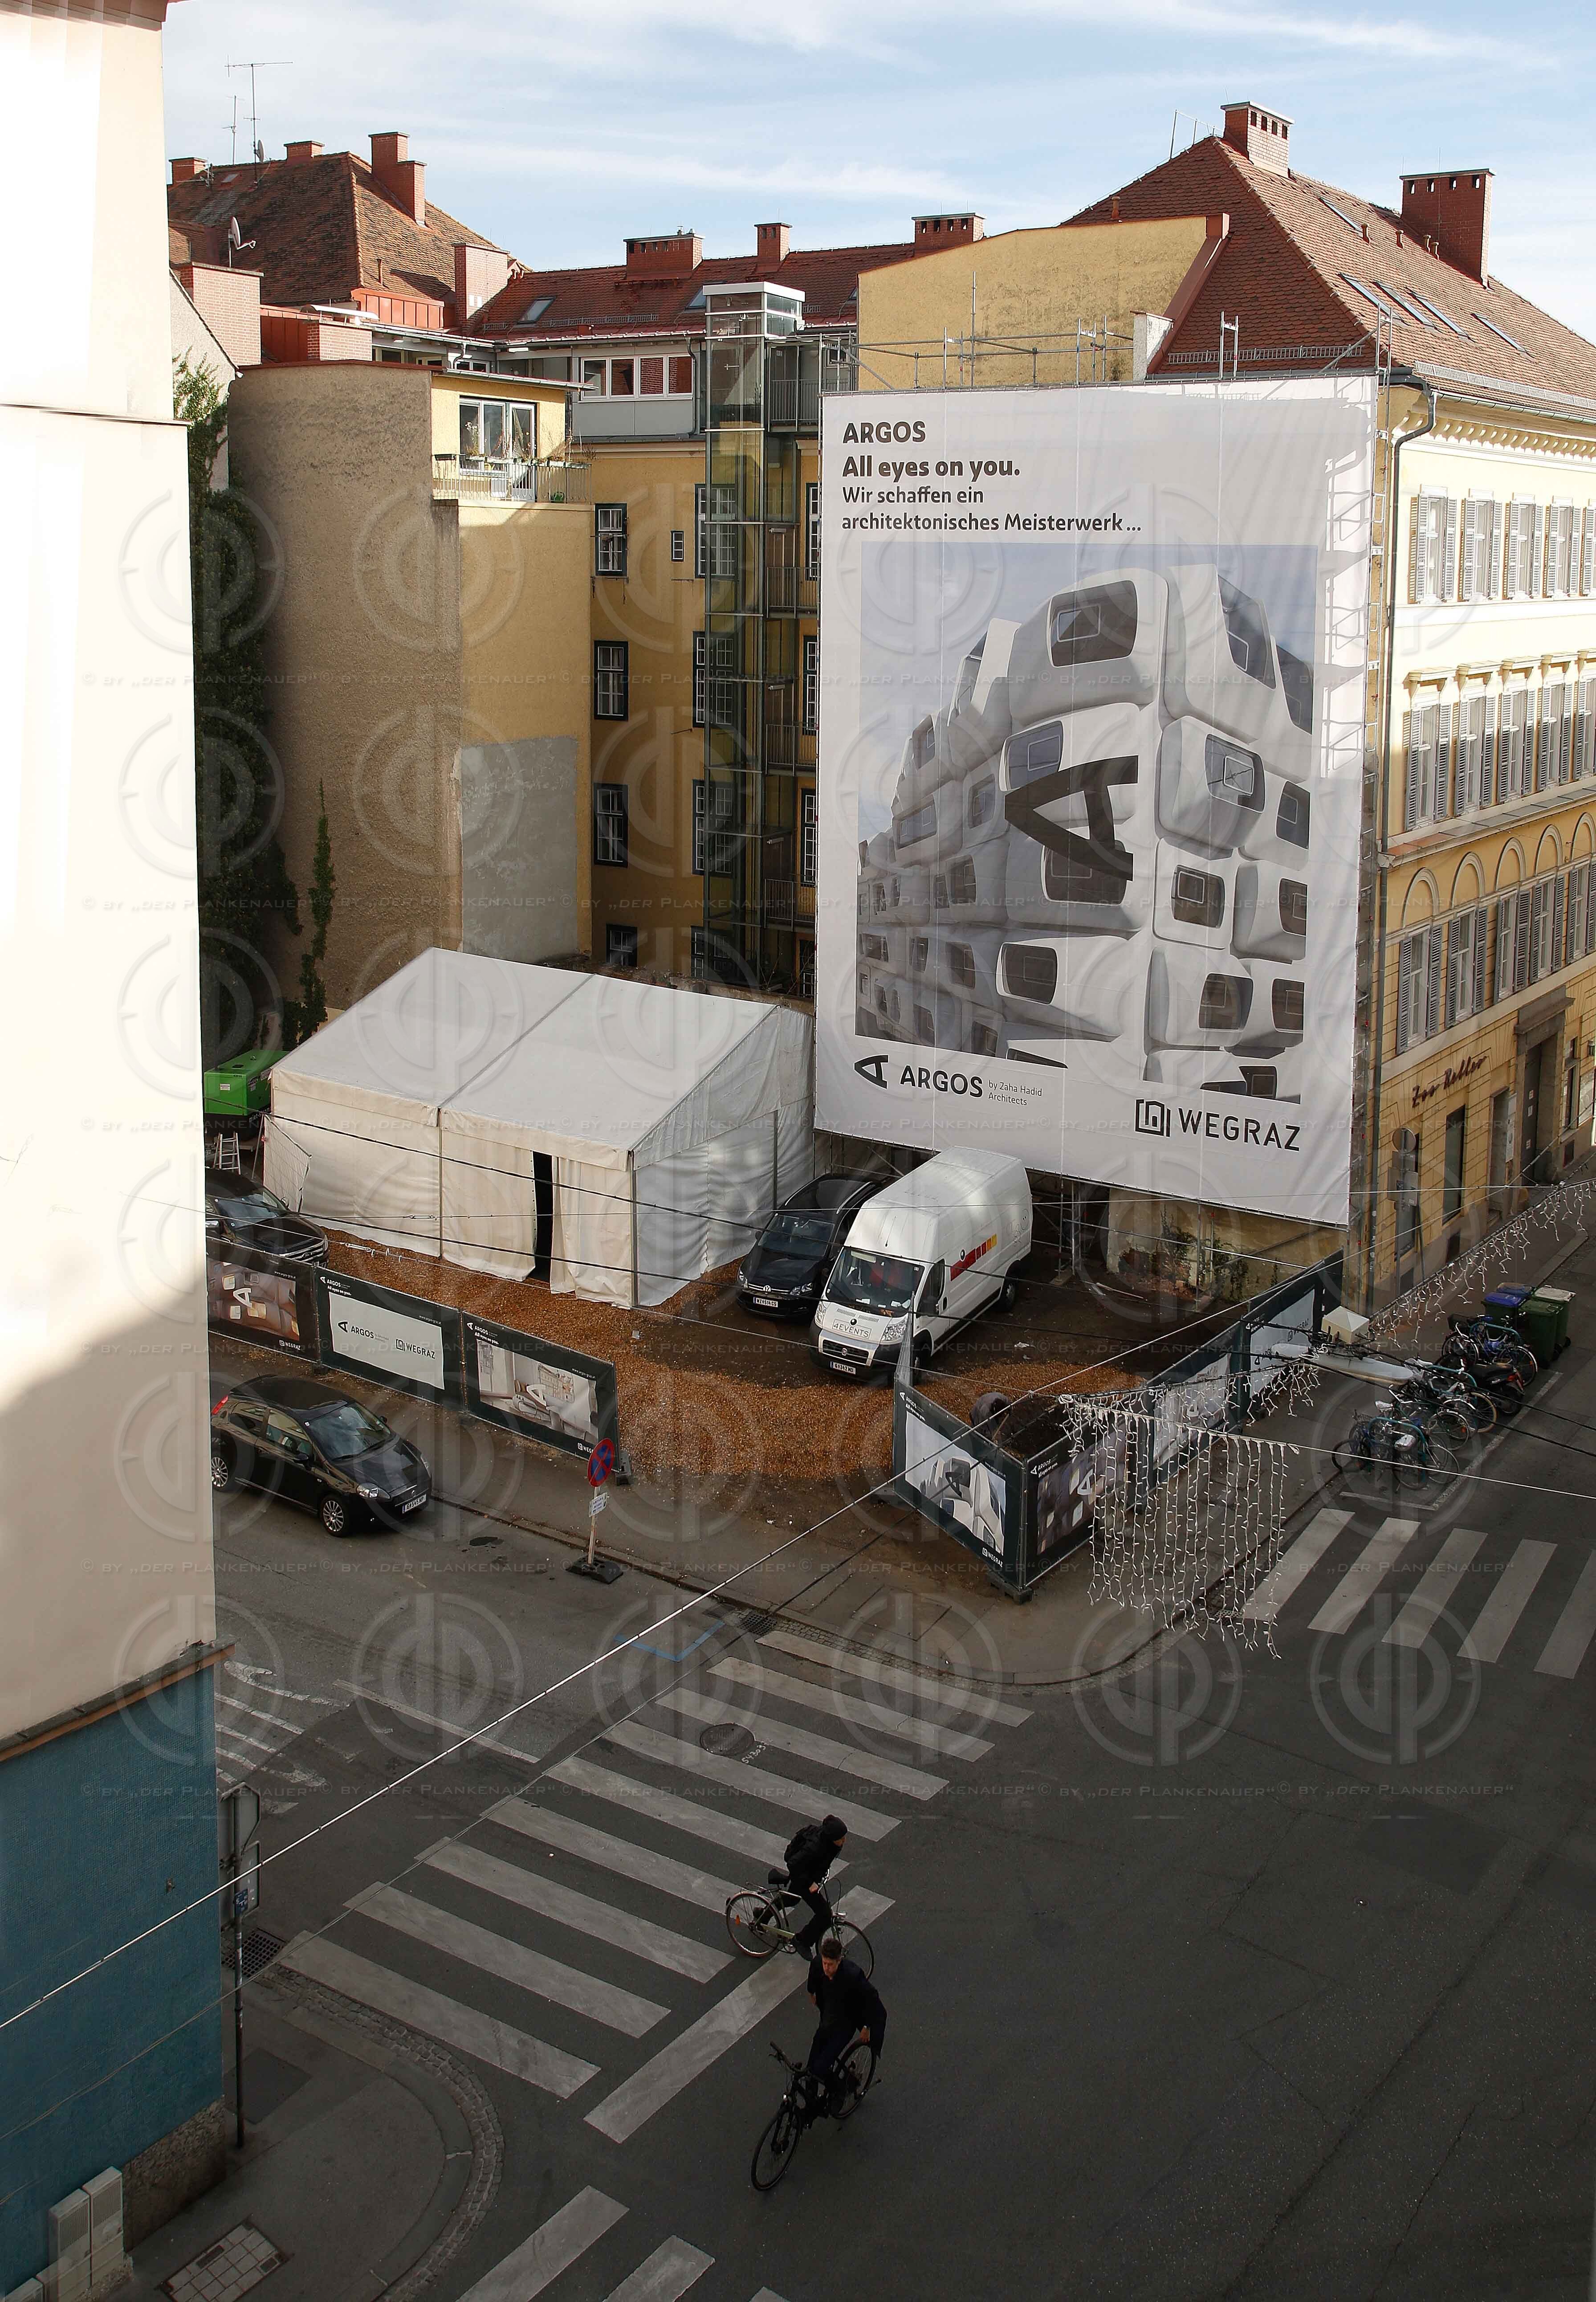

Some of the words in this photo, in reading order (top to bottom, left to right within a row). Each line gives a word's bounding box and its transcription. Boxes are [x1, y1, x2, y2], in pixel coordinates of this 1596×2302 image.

[843, 421, 926, 444] ARGOS
[842, 455, 872, 477] All
[878, 461, 929, 483] eyes
[935, 461, 963, 476] on
[969, 461, 1020, 482] you.
[843, 486, 873, 503] Wir
[877, 486, 951, 503] schaffen
[957, 486, 983, 503] ein
[842, 512, 999, 531] architektonisches
[900, 1065, 983, 1098] ARGOS
[989, 1080, 998, 1090] by
[1000, 1082, 1018, 1092] Zaha
[1020, 1086, 1042, 1096] Hadid
[988, 1092, 1027, 1106] Architects
[1178, 1107, 1301, 1151] WEGRAZ
[327, 1278, 342, 1288] ARGOS
[833, 1322, 869, 1338] 4EVENTS
[285, 1342, 301, 1351] WEGRAZ
[351, 1326, 375, 1339] ARGOS
[406, 1343, 436, 1359] WEGRAZ
[988, 1551, 1003, 1568] WEGRAZ
